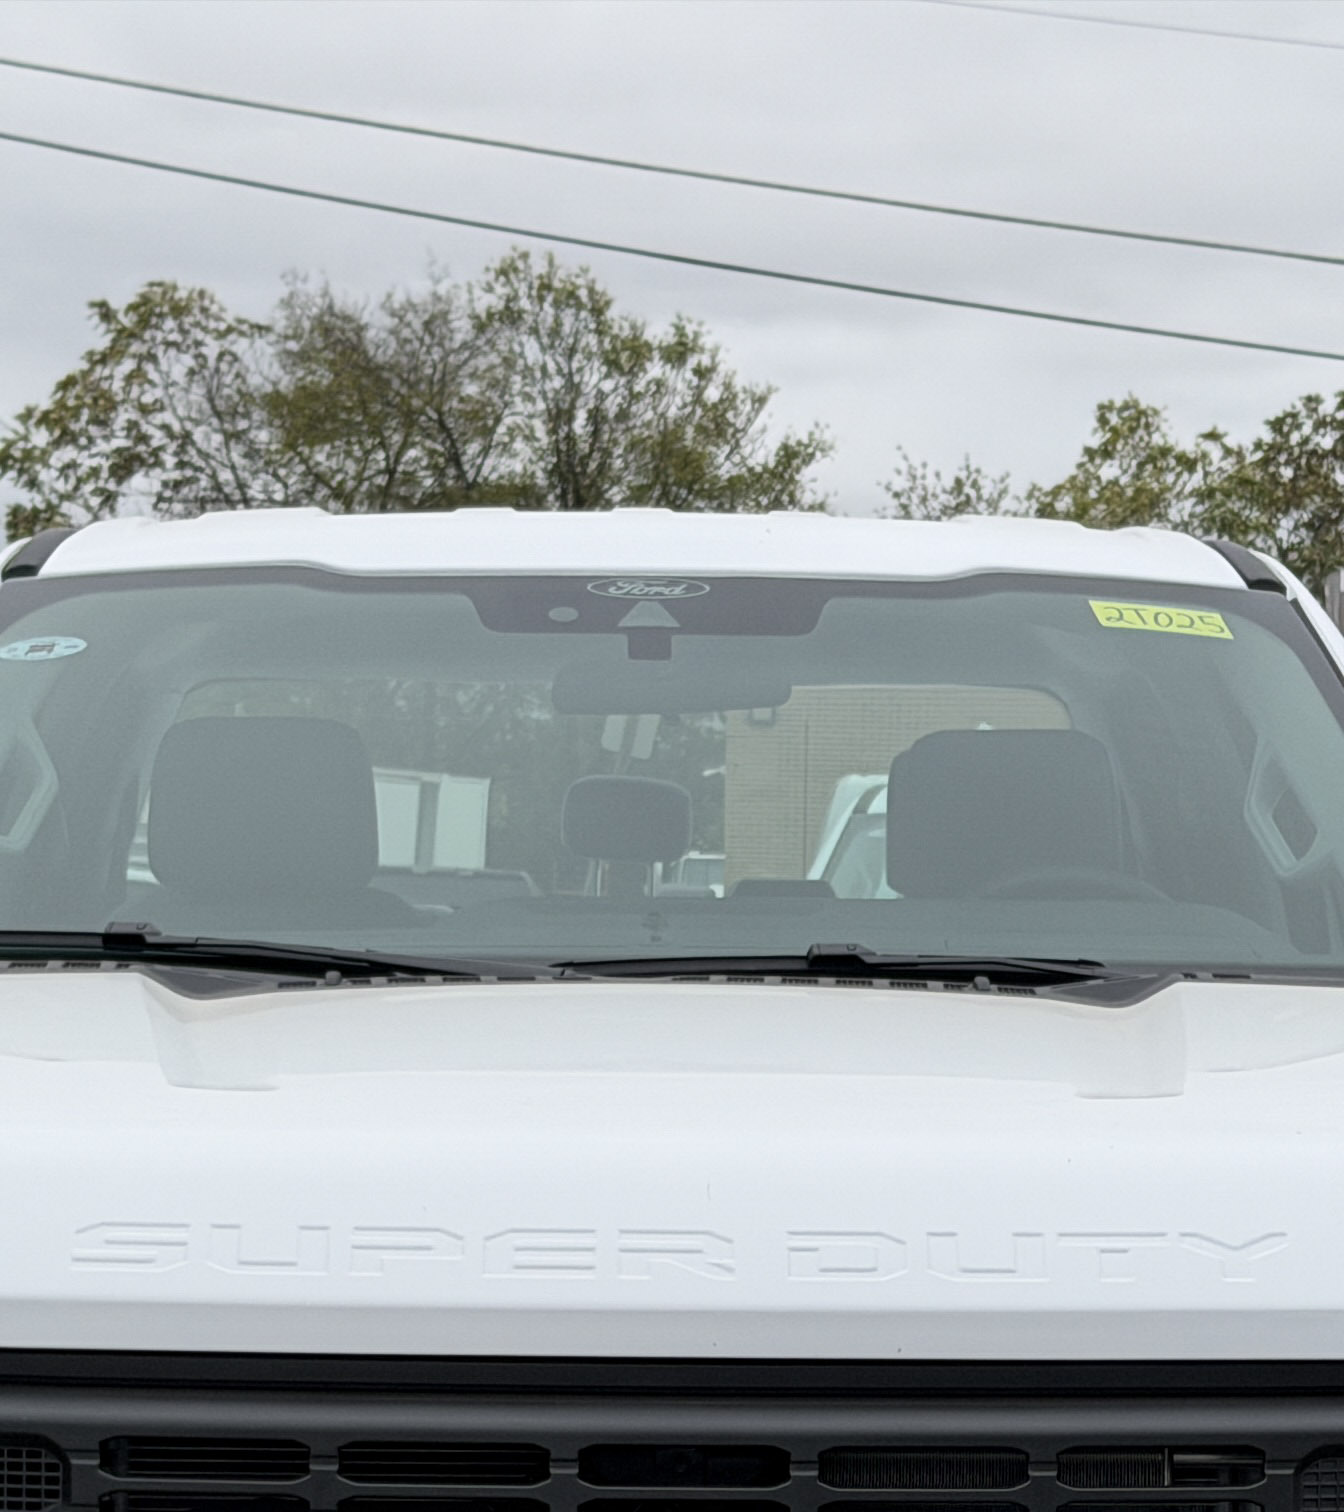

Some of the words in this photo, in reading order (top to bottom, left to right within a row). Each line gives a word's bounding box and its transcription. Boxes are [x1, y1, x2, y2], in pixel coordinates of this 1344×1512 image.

[608, 580, 688, 595] Ford
[68, 1221, 736, 1282] SUPER
[786, 1230, 1290, 1283] DUTY
